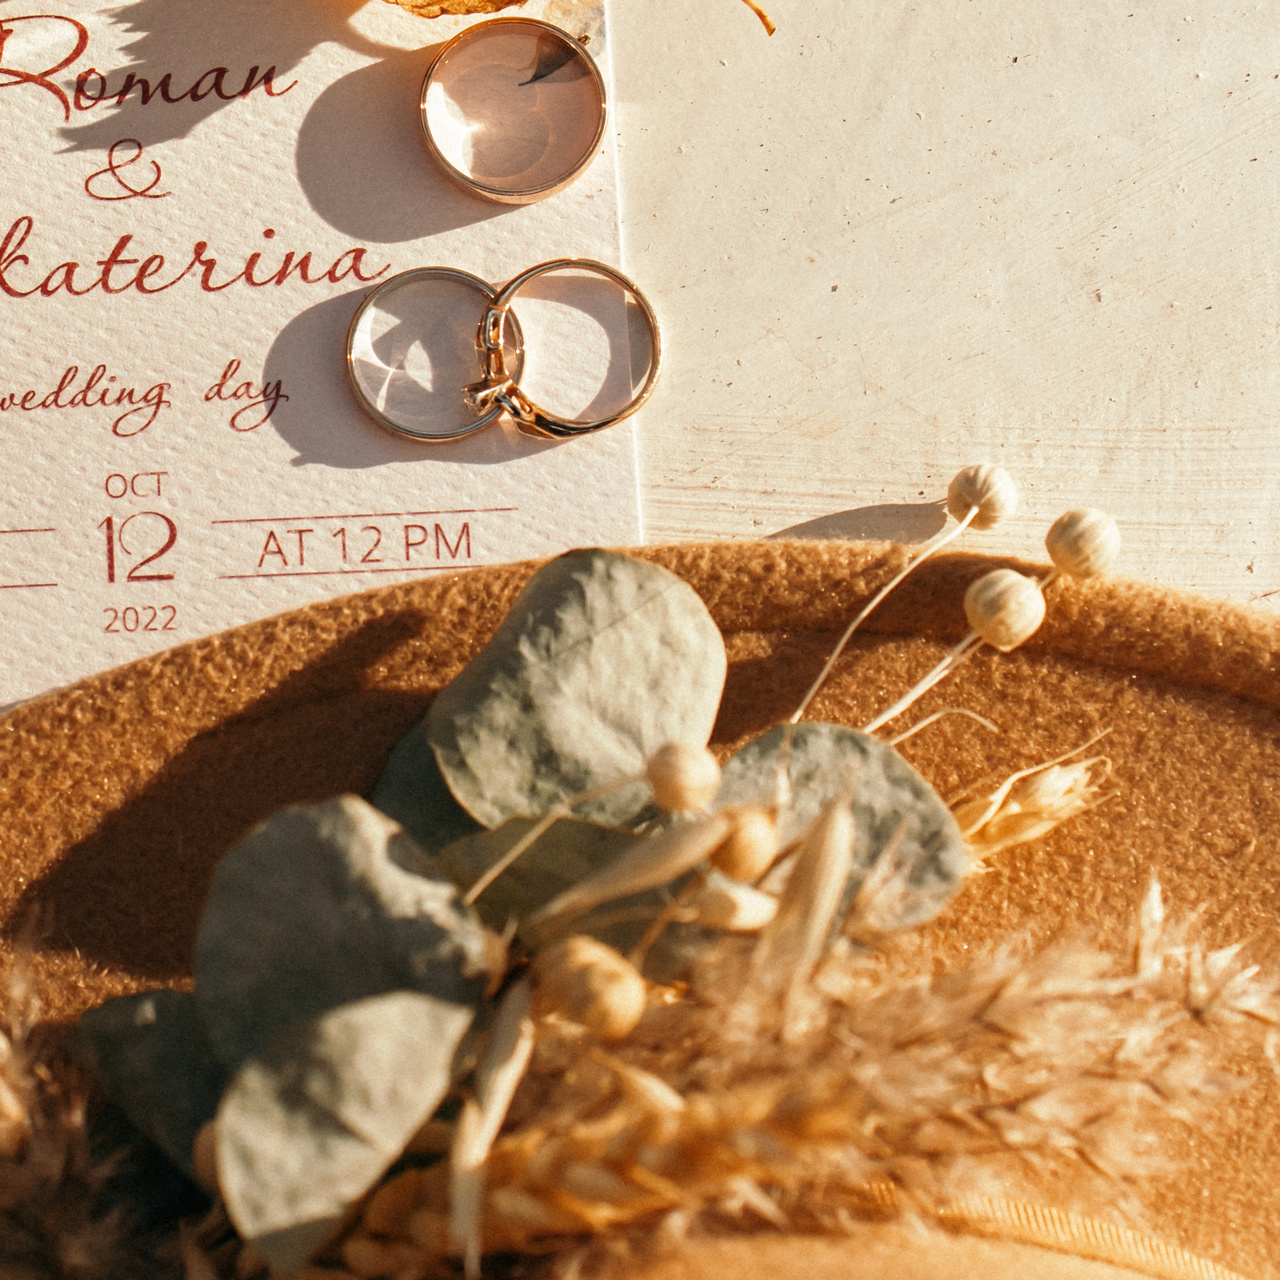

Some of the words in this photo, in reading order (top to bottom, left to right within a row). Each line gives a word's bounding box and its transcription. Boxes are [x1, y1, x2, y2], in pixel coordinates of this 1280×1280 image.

[84, 137, 172, 201] &
[203, 358, 290, 432] day
[104, 471, 169, 499] OCT
[96, 510, 178, 583] 12
[257, 528, 314, 568] AT
[332, 525, 384, 564] 12
[404, 521, 472, 562] PM
[102, 604, 179, 634] 2022
